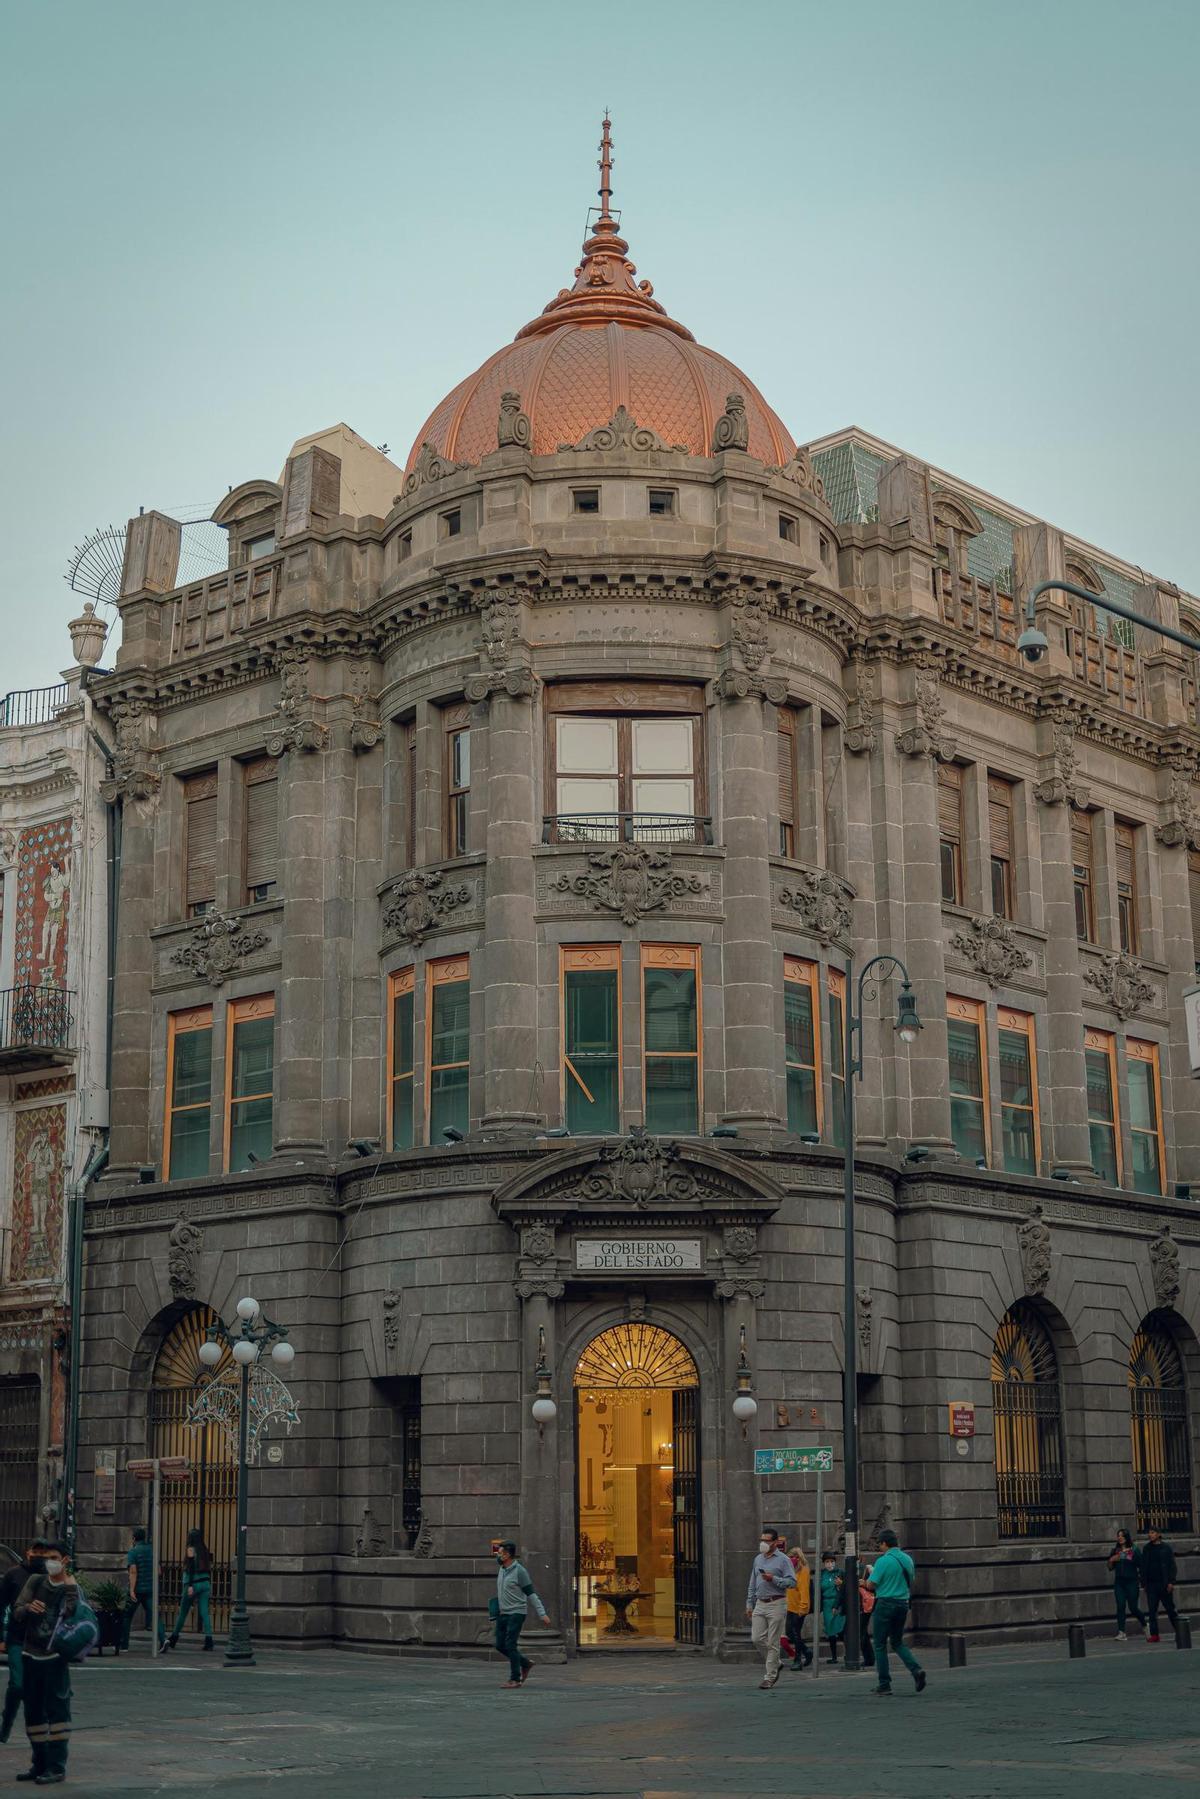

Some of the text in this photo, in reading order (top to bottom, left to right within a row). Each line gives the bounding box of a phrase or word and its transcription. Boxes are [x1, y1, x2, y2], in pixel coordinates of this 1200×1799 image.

[602, 1242, 676, 1254] GOBIERNO
[594, 1255, 683, 1267] DEL ESTADO
